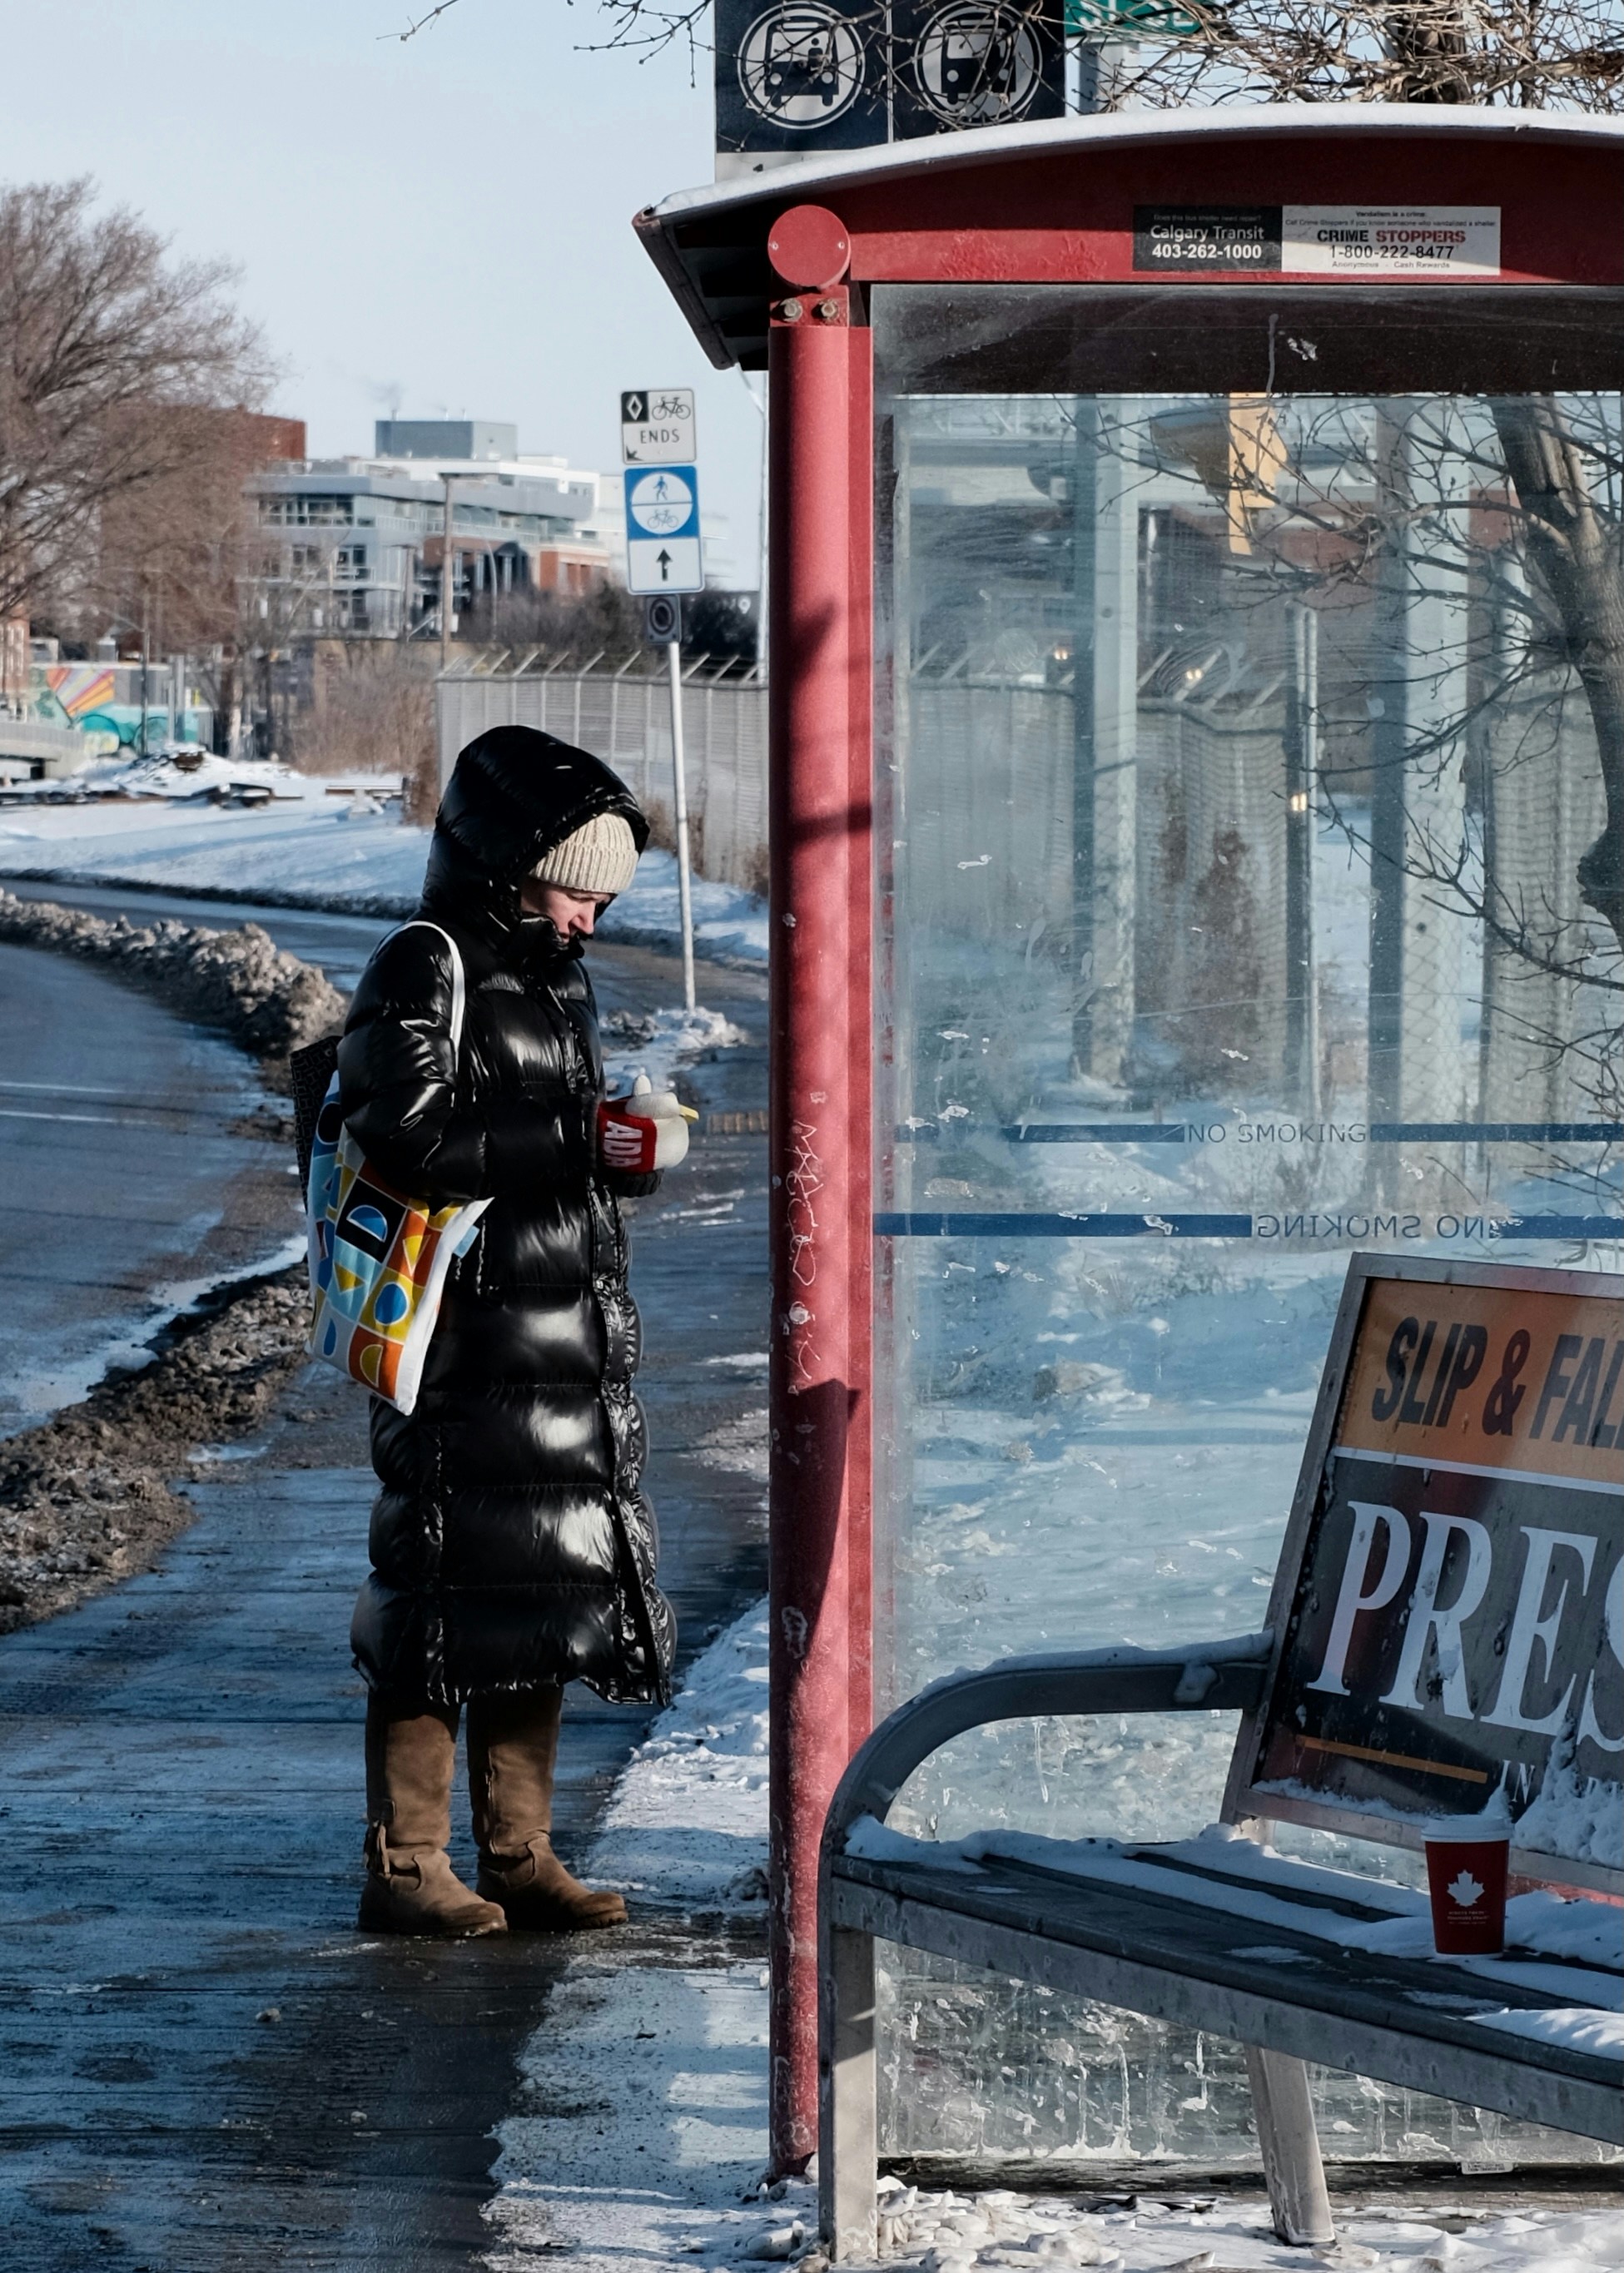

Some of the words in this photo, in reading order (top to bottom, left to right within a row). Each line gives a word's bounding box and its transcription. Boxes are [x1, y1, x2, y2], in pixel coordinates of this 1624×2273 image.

[1150, 225, 1208, 242] Calgary
[1213, 226, 1264, 241] Transit
[1317, 230, 1368, 243] CRIME
[1376, 230, 1466, 243] STOPPERS
[1152, 244, 1262, 259] 403-262-1000
[1331, 245, 1454, 258] 1-800-222-8477
[1332, 261, 1378, 269] Anonymous
[640, 428, 680, 444] ENDS
[1189, 1124, 1226, 1144] NO
[1238, 1124, 1366, 1144] SMOKING
[1372, 1317, 1488, 1428] SLIP
[1482, 1328, 1531, 1437] &
[1530, 1333, 1624, 1450] FAL
